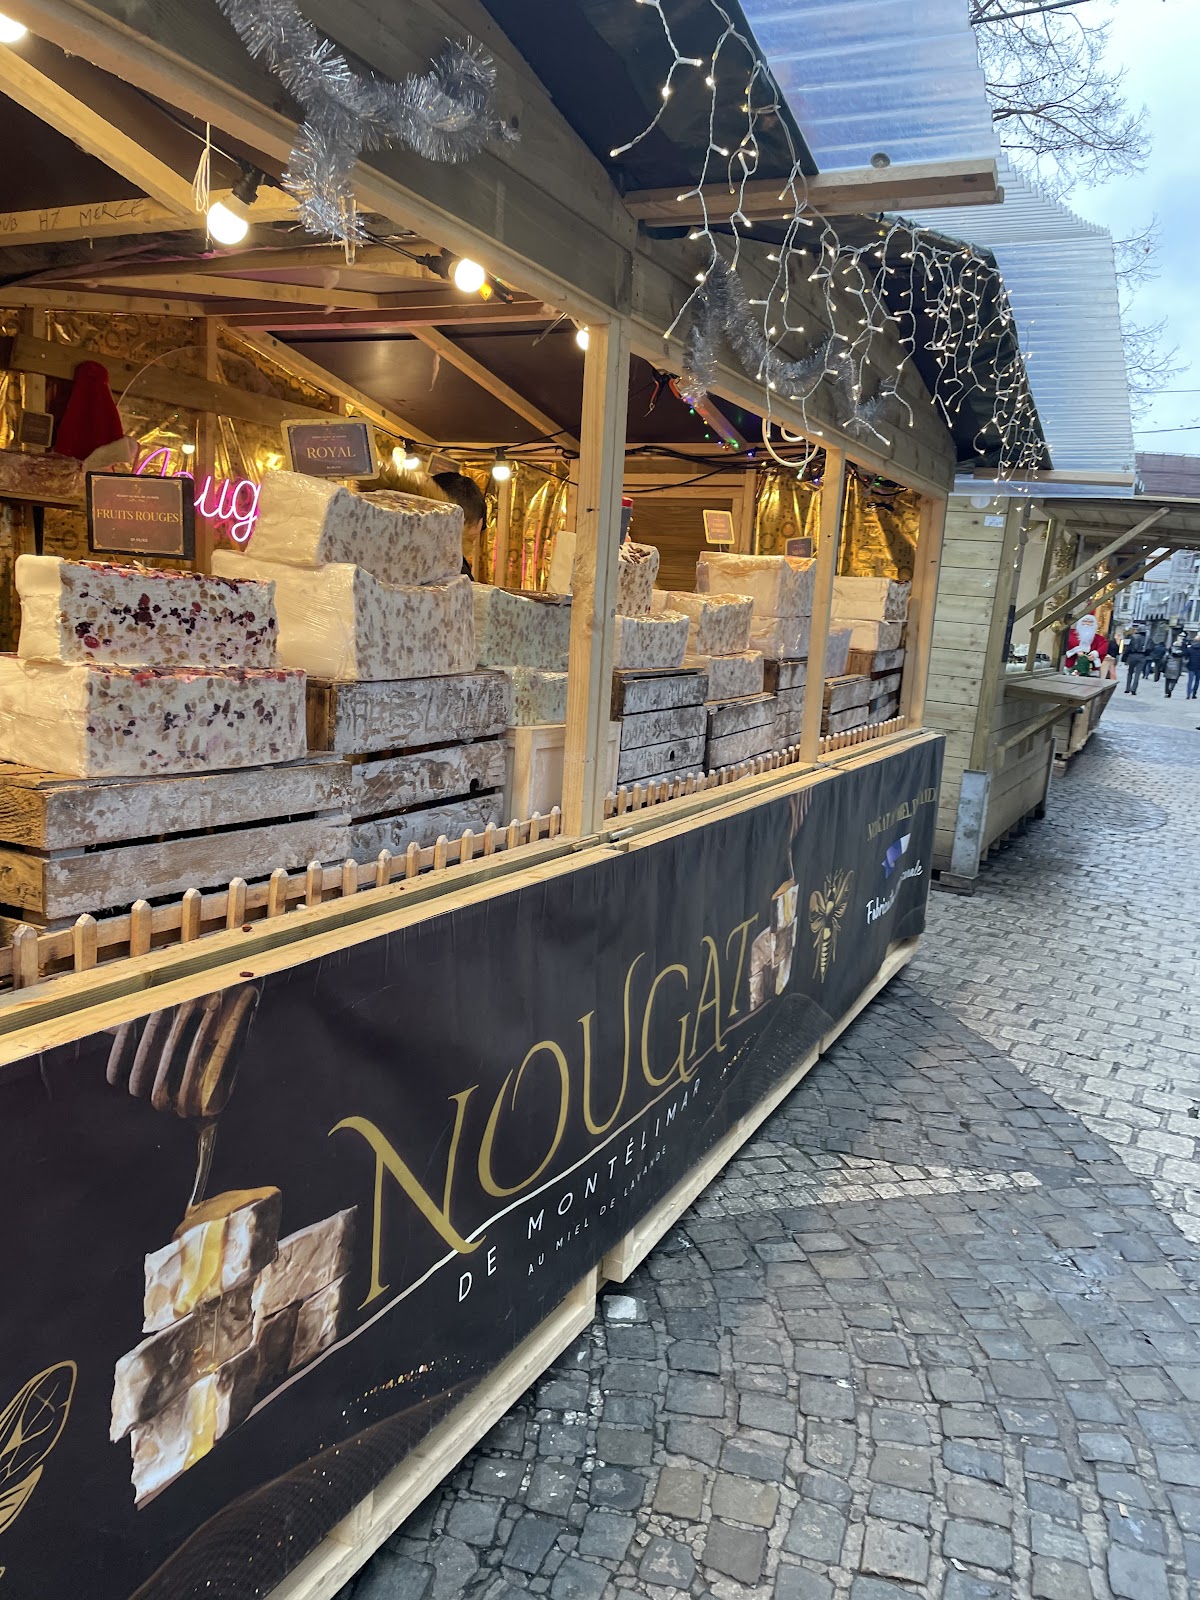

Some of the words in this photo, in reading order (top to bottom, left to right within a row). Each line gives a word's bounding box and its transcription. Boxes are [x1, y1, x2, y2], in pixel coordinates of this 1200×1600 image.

[96, 508, 134, 520] FRUITS
[135, 511, 179, 523] ROUGES
[306, 446, 356, 459] ROYAL
[327, 913, 759, 1310] NOUGAT
[458, 1246, 497, 1302] DE
[526, 1078, 700, 1239] MONTÉLIMAR
[528, 1253, 545, 1276] AU
[555, 1218, 589, 1250] MIEL
[600, 1197, 616, 1216] DE
[624, 1145, 666, 1196] LAVANDE
